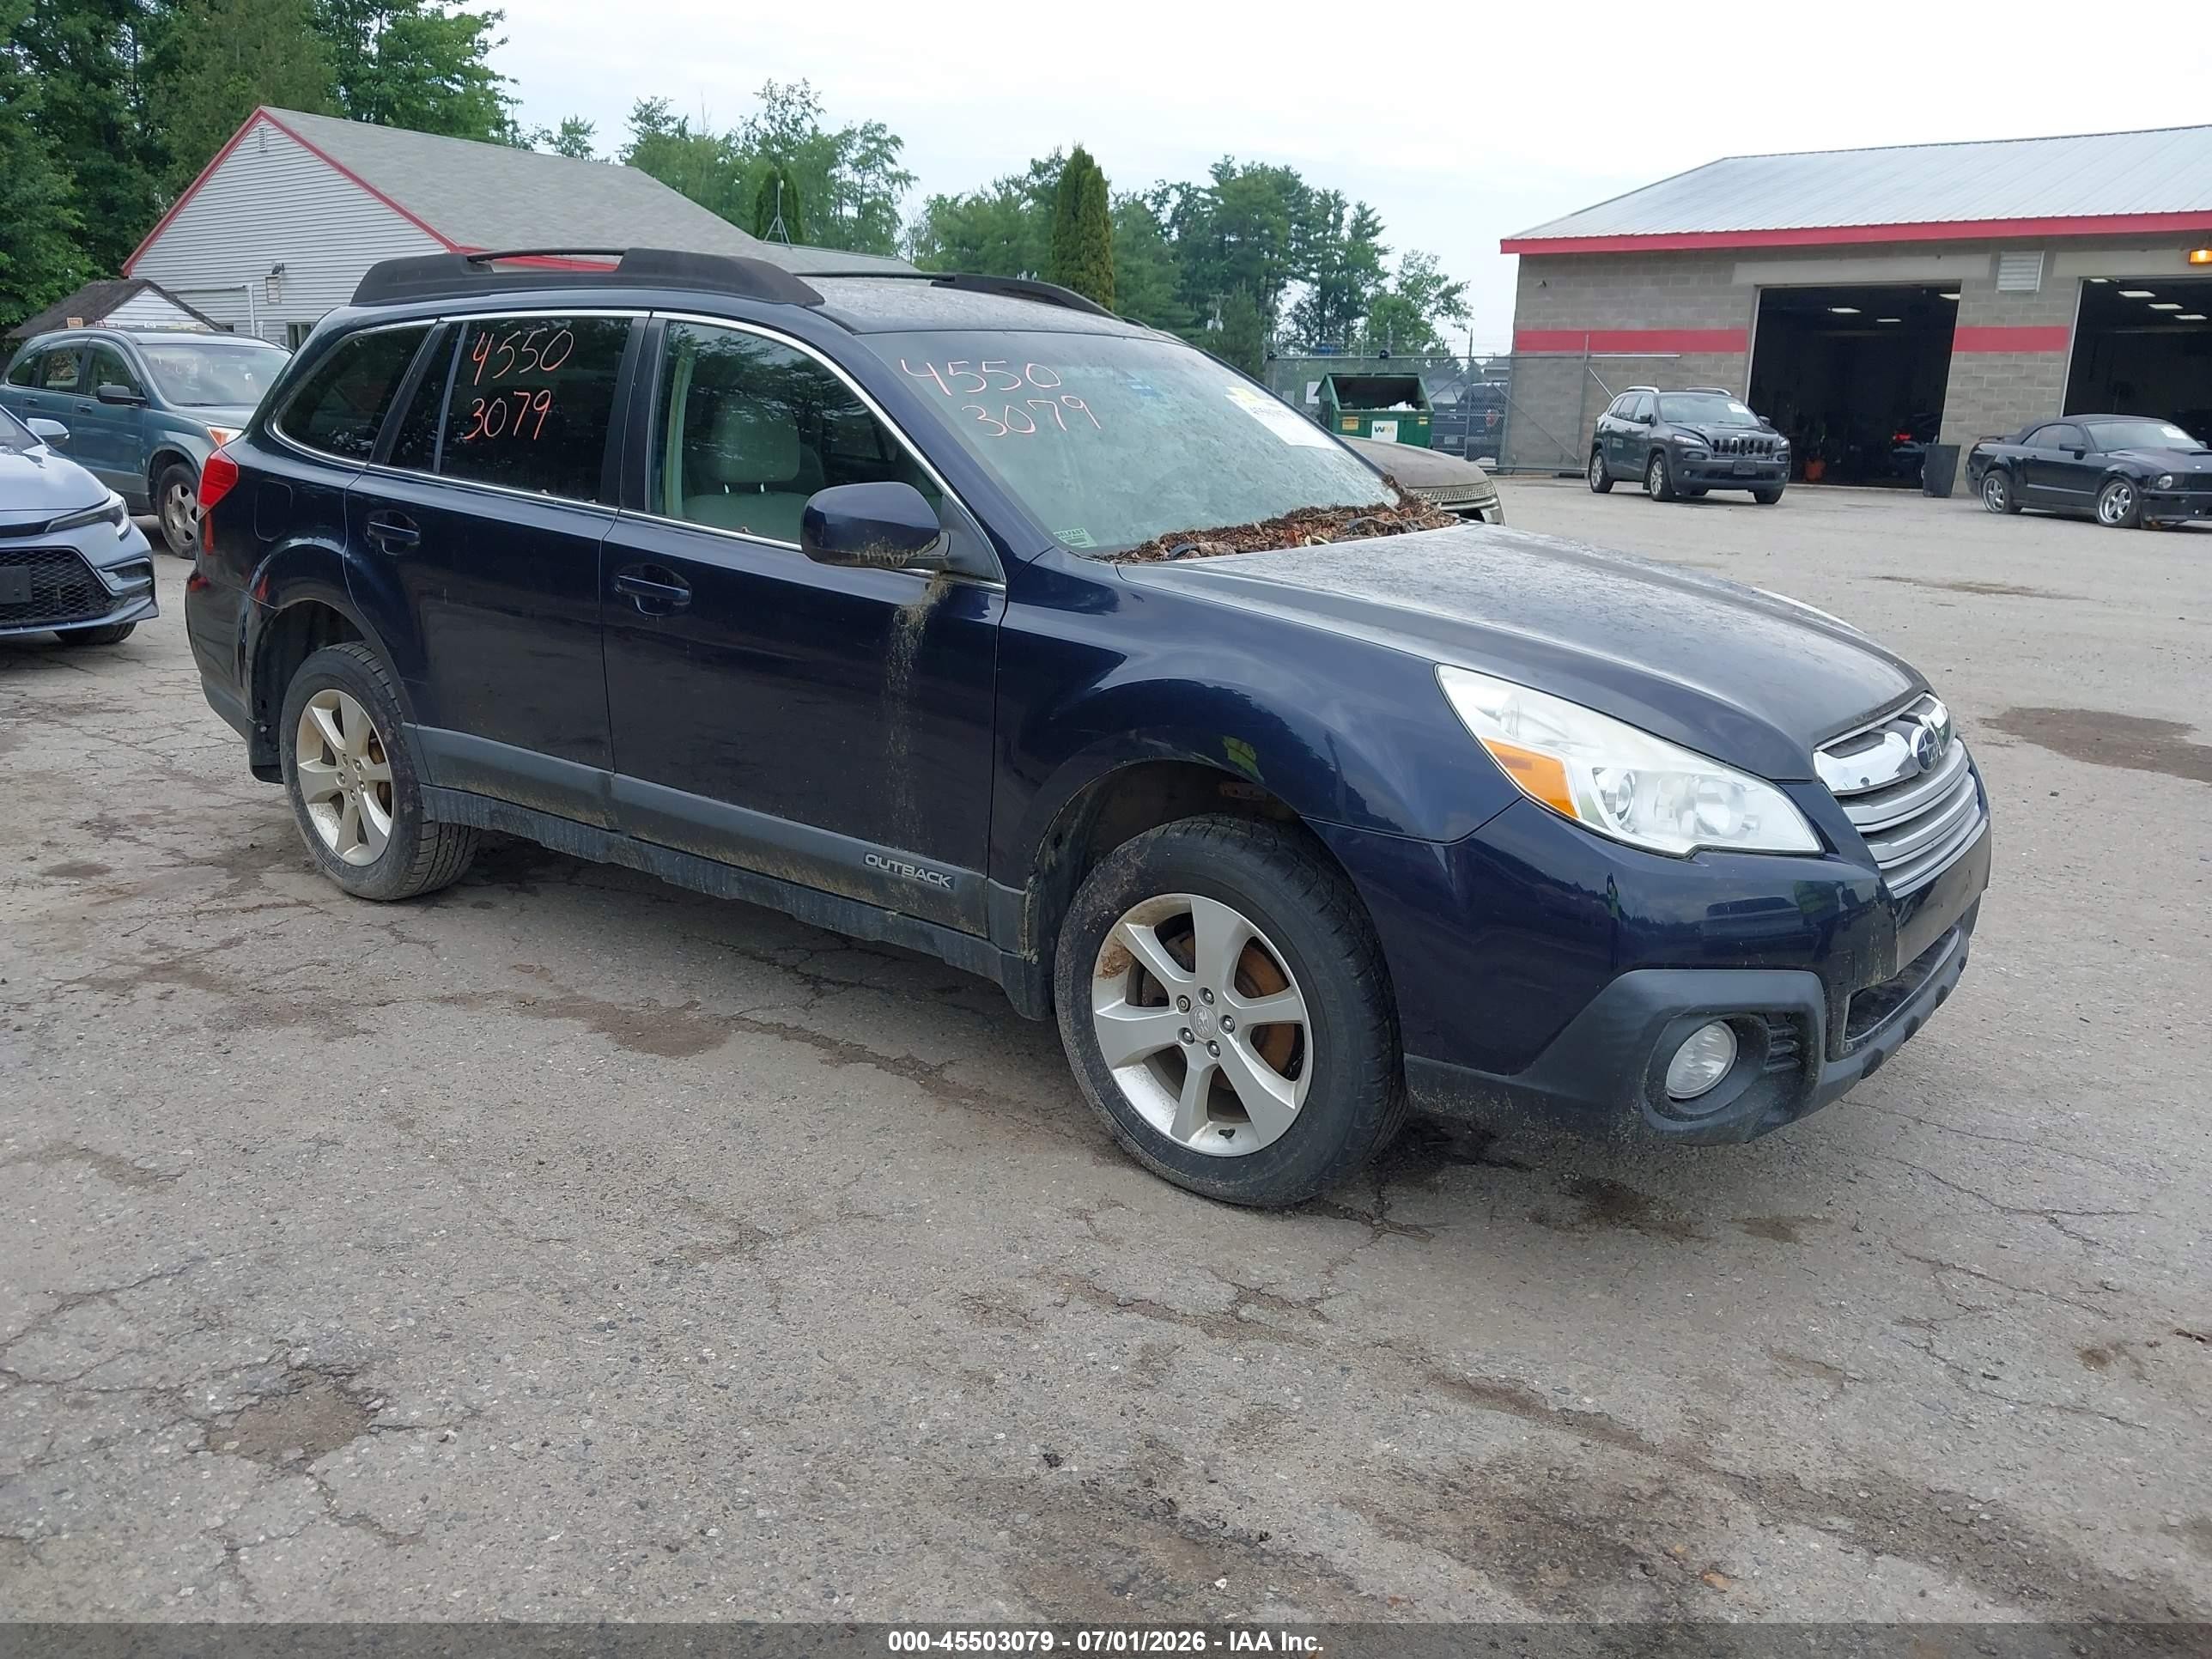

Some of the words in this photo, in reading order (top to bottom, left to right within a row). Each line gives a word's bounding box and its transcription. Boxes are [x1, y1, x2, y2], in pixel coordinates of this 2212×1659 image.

[472, 327, 574, 386] 4550
[900, 359, 1061, 397] 4550
[464, 389, 551, 440] 3079
[961, 395, 1102, 436] 3079
[865, 854, 951, 888] OUTBACK
